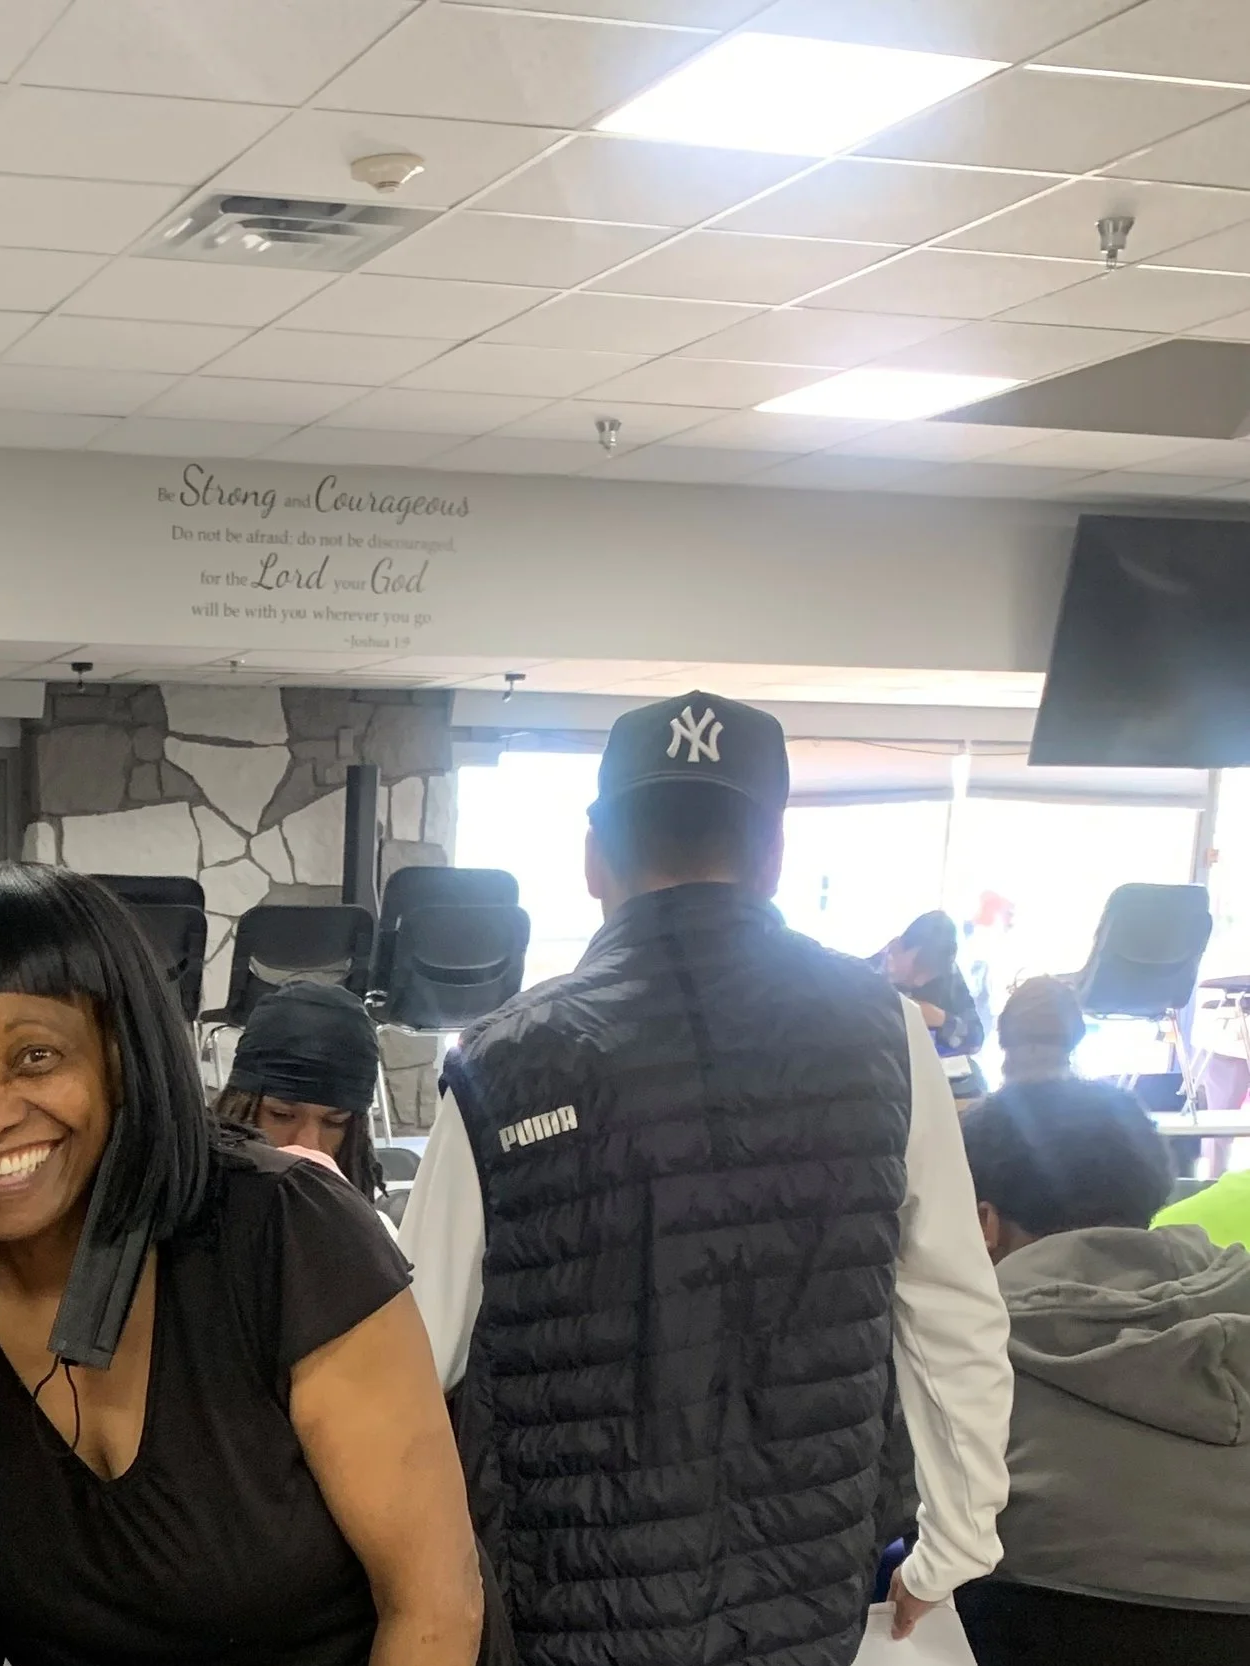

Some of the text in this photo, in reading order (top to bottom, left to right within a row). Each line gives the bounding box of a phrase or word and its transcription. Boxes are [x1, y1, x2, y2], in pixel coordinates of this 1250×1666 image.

[158, 463, 470, 525] Be Strong and Courageous
[171, 525, 193, 541] Do
[198, 529, 221, 542] not
[225, 527, 243, 543] be
[297, 531, 316, 546] do
[320, 533, 342, 547] not
[348, 532, 364, 548] be
[200, 552, 429, 595] for the Lord your God
[191, 602, 219, 617] will
[223, 602, 240, 617] be
[245, 604, 277, 619] with
[281, 608, 306, 624] you
[312, 606, 380, 622] wherever
[383, 611, 409, 628] you
[666, 705, 724, 763] NY
[498, 1104, 578, 1153] PUMA
